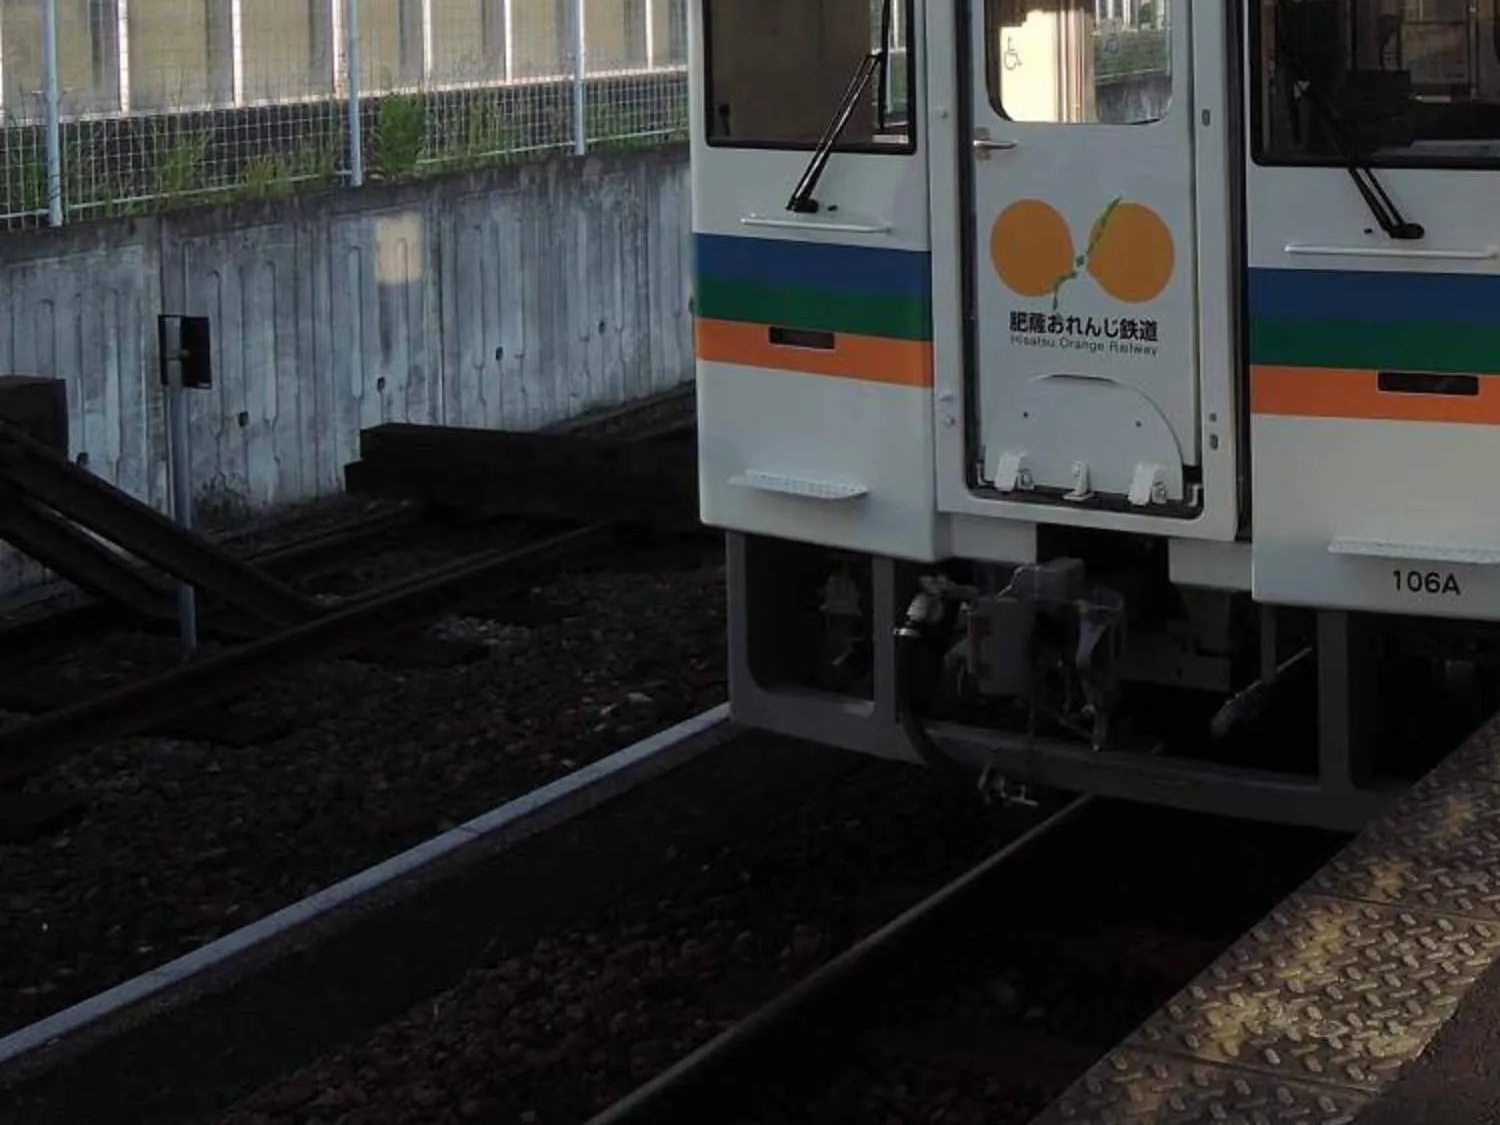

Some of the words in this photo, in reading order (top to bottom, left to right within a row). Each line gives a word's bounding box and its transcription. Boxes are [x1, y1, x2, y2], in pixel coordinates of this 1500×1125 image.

[1009, 311, 1158, 342] 肥薩おれんじ鉄道
[1010, 334, 1055, 348] Hisatsu
[1059, 337, 1105, 353] Orange
[1109, 340, 1158, 357] Railway
[1392, 569, 1462, 597] 106A
